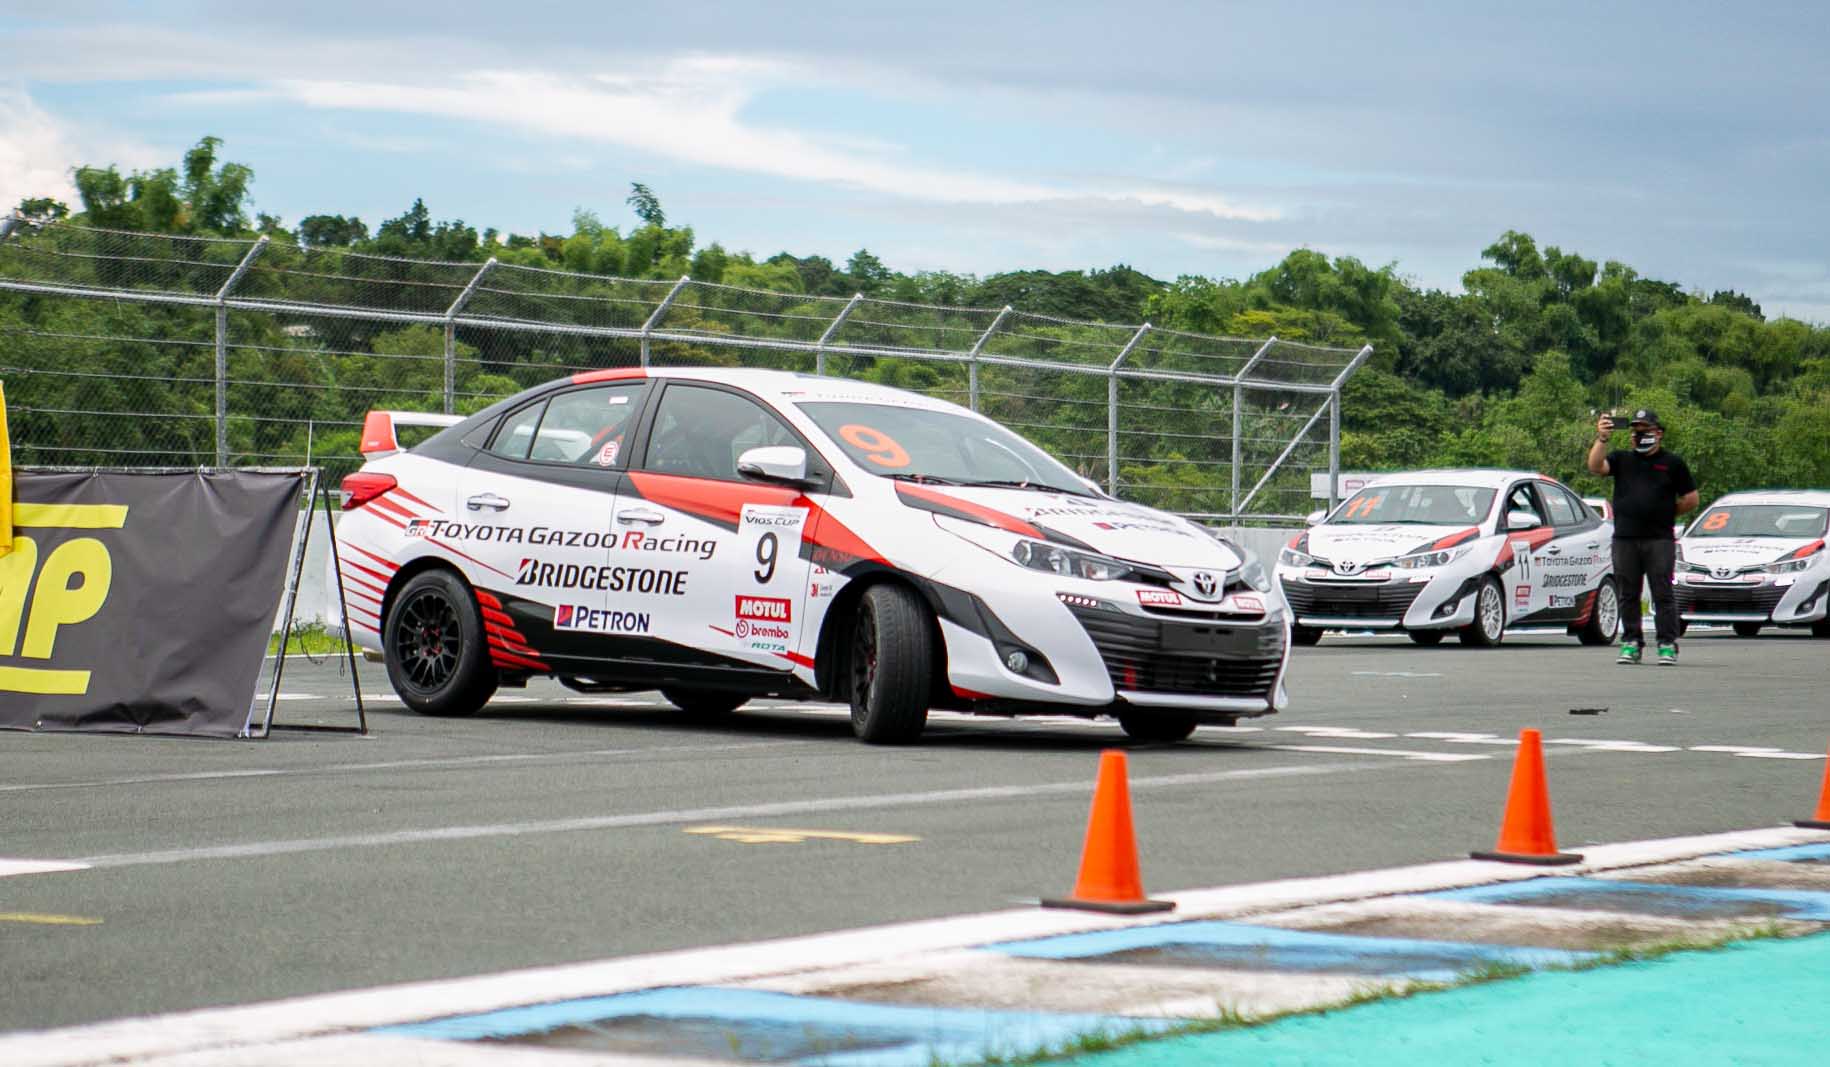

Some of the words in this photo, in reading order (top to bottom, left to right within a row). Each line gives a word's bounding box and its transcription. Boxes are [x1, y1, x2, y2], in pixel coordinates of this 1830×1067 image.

[838, 423, 912, 468] 9
[1345, 495, 1382, 518] 11
[774, 517, 800, 527] CUP
[1702, 512, 1731, 530] 8
[431, 519, 523, 543] TOYOTA
[528, 527, 617, 549] GAZOO
[621, 531, 718, 560] Racing
[754, 531, 778, 584] 9
[1519, 554, 1530, 580] 11
[515, 558, 689, 596] BRIDGESTONE
[574, 606, 651, 633] PETRON
[739, 599, 787, 619] MOTUL
[751, 623, 789, 639] brembo
[751, 643, 786, 651] ROTA
